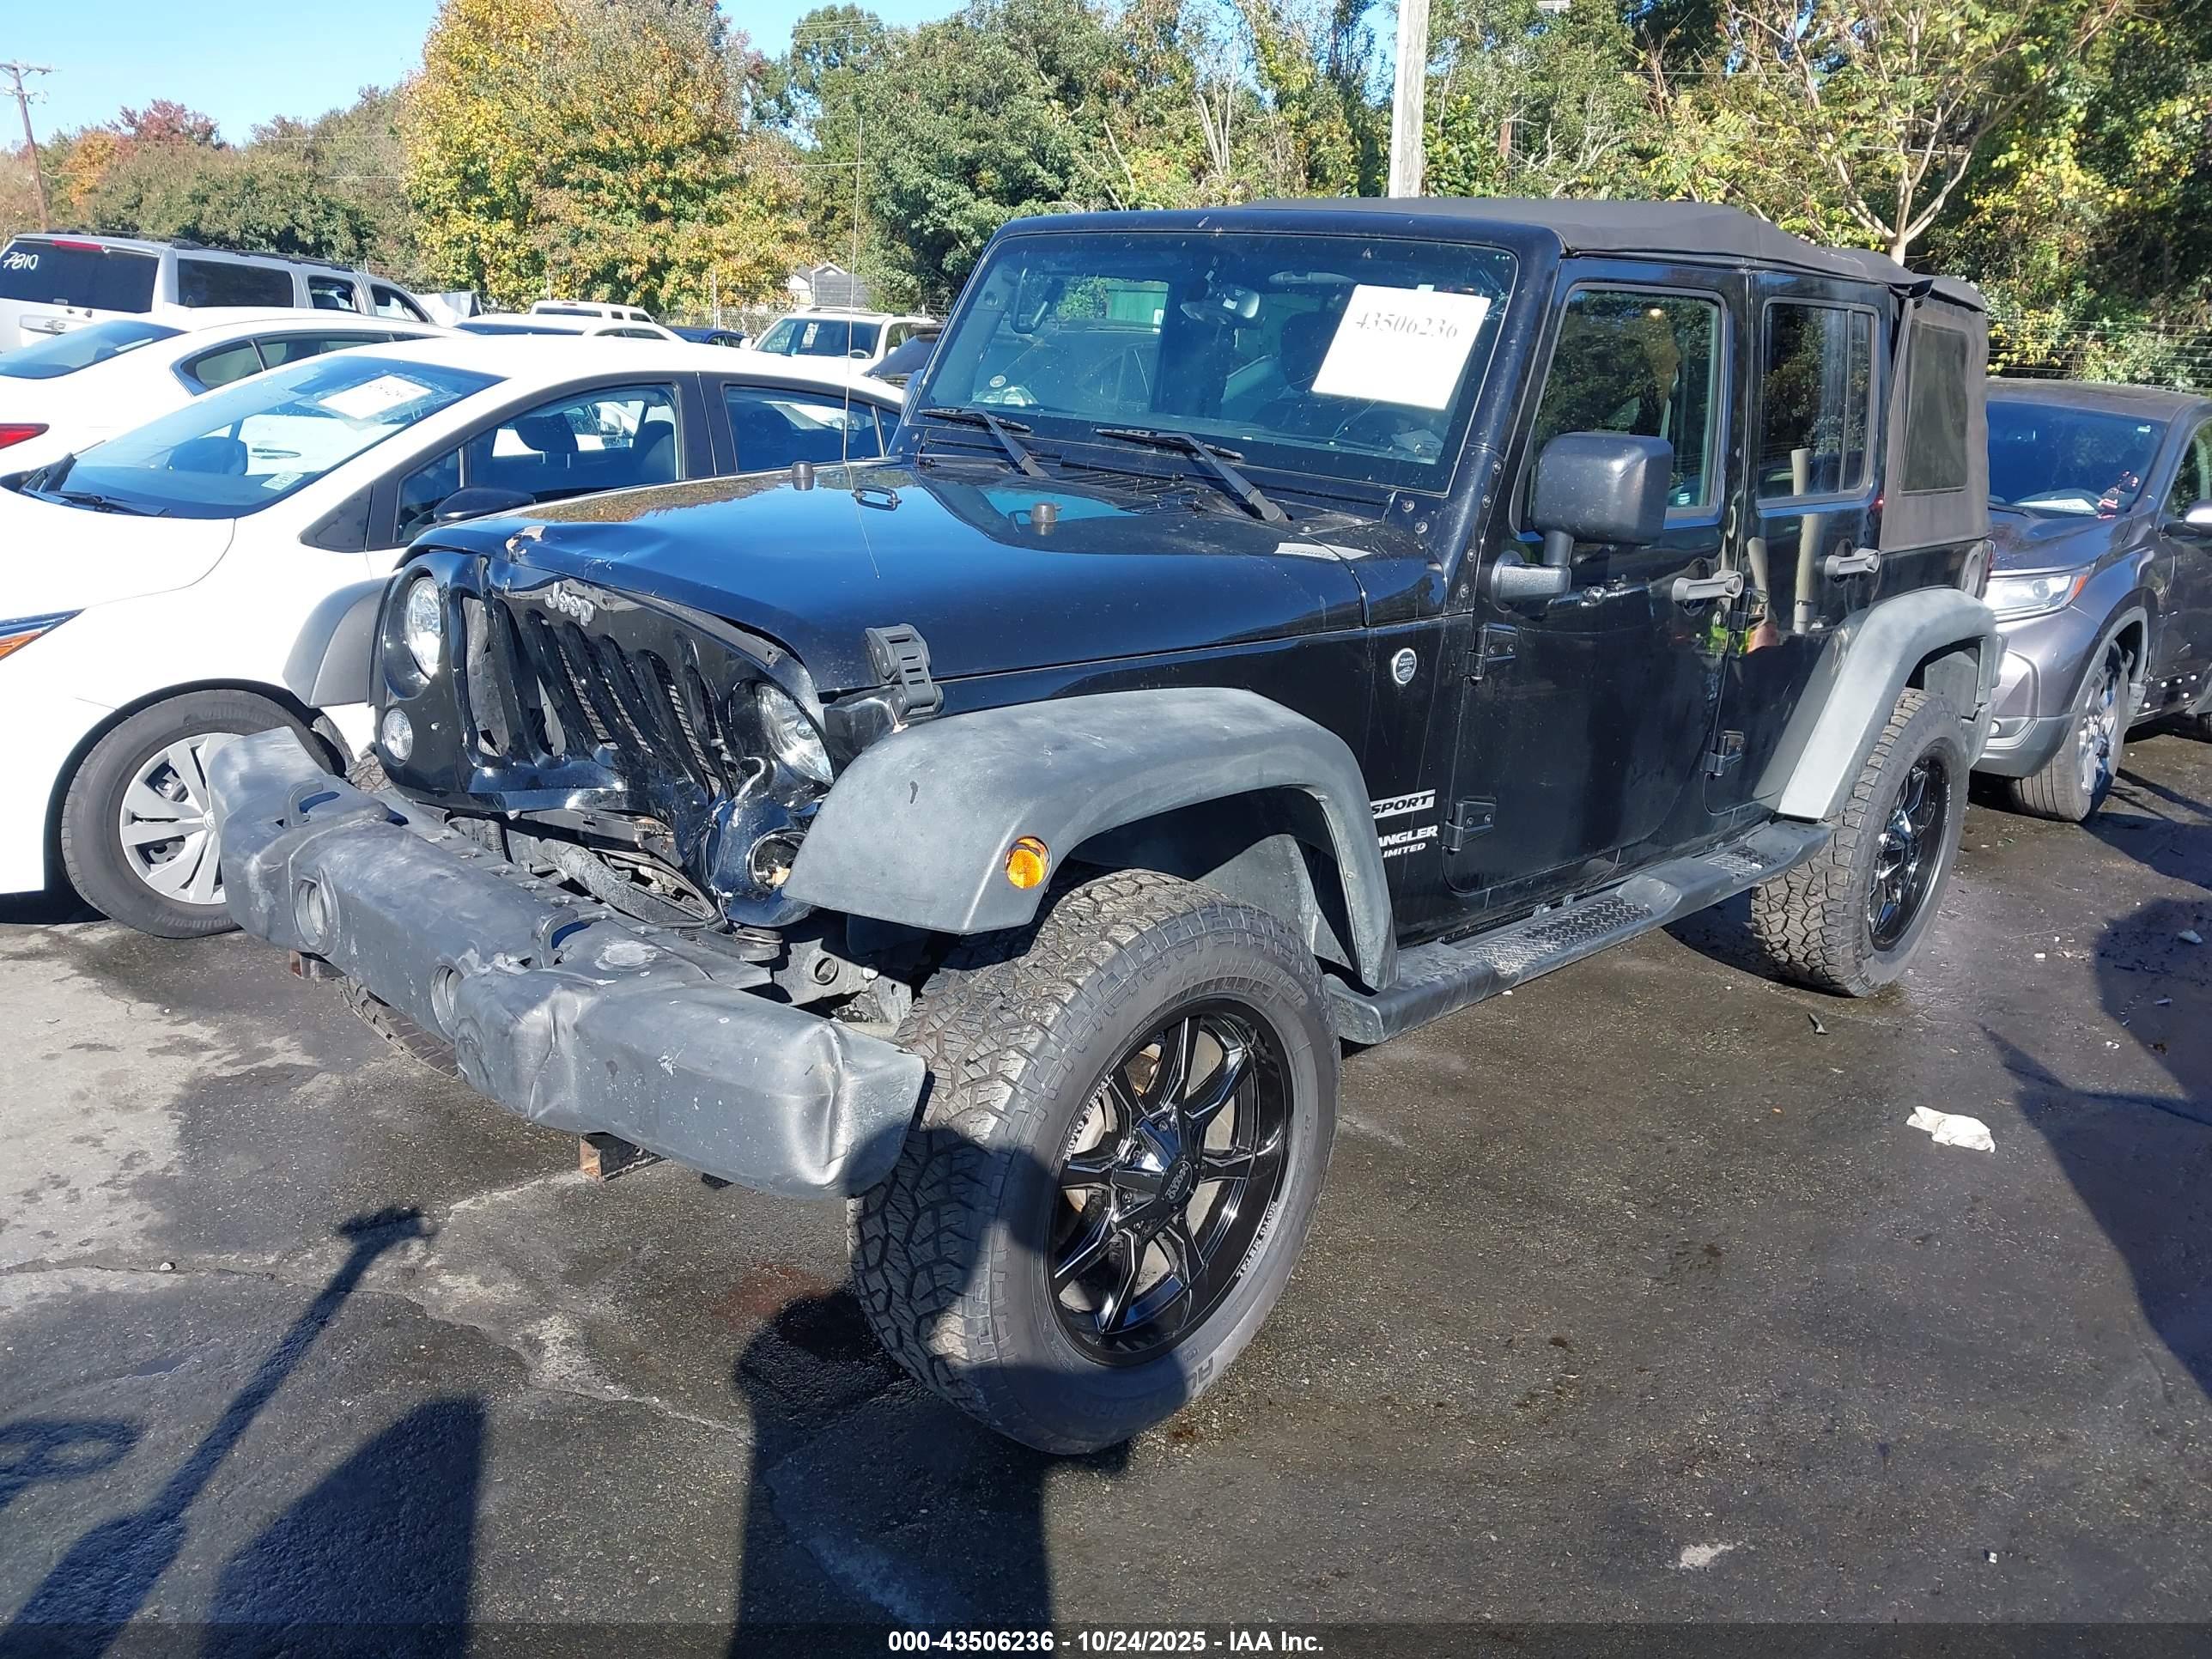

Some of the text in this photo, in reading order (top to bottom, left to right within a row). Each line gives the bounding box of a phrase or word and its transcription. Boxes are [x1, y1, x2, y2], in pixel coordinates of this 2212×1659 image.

[3, 252, 40, 270] 7810
[544, 581, 595, 626] Jeep
[1370, 793, 1435, 815] SPORT
[1062, 1073, 1114, 1162] MOTO METAL
[1237, 1200, 1278, 1279] MOTO METAL
